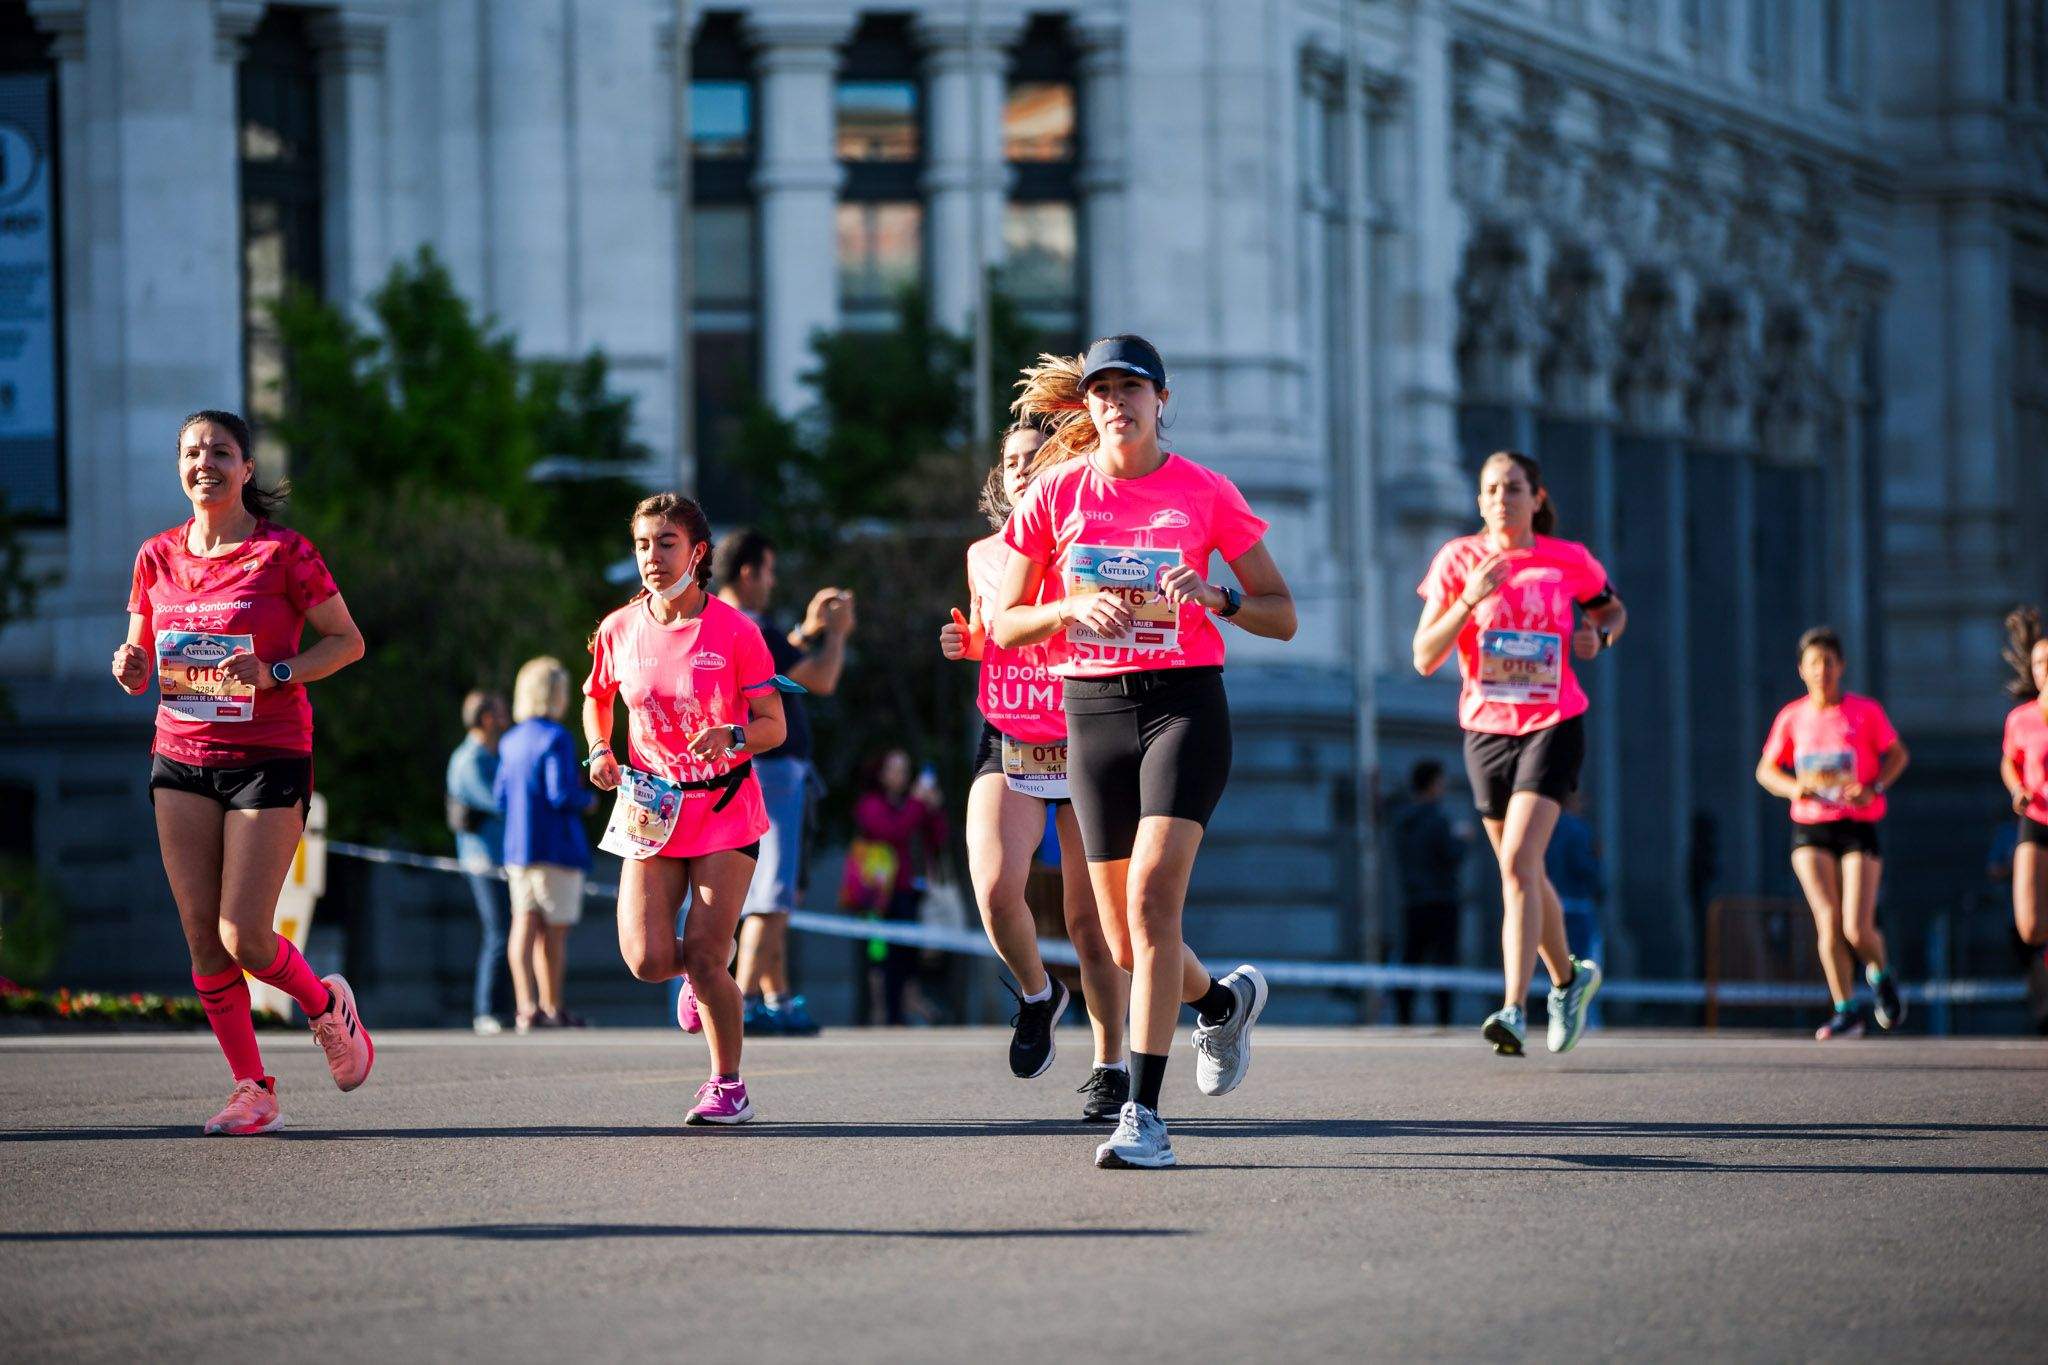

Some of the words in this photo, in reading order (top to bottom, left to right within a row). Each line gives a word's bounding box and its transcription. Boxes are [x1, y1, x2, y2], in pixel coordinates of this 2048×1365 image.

[1101, 564, 1146, 576] ASTURIANA
[154, 603, 185, 614] Sports
[199, 600, 252, 612] Santander
[1132, 620, 1154, 628] MUJER
[1075, 627, 1104, 639] OYSH
[186, 648, 225, 656] ASTURIANA
[186, 665, 223, 682] 016
[195, 685, 215, 694] 2284
